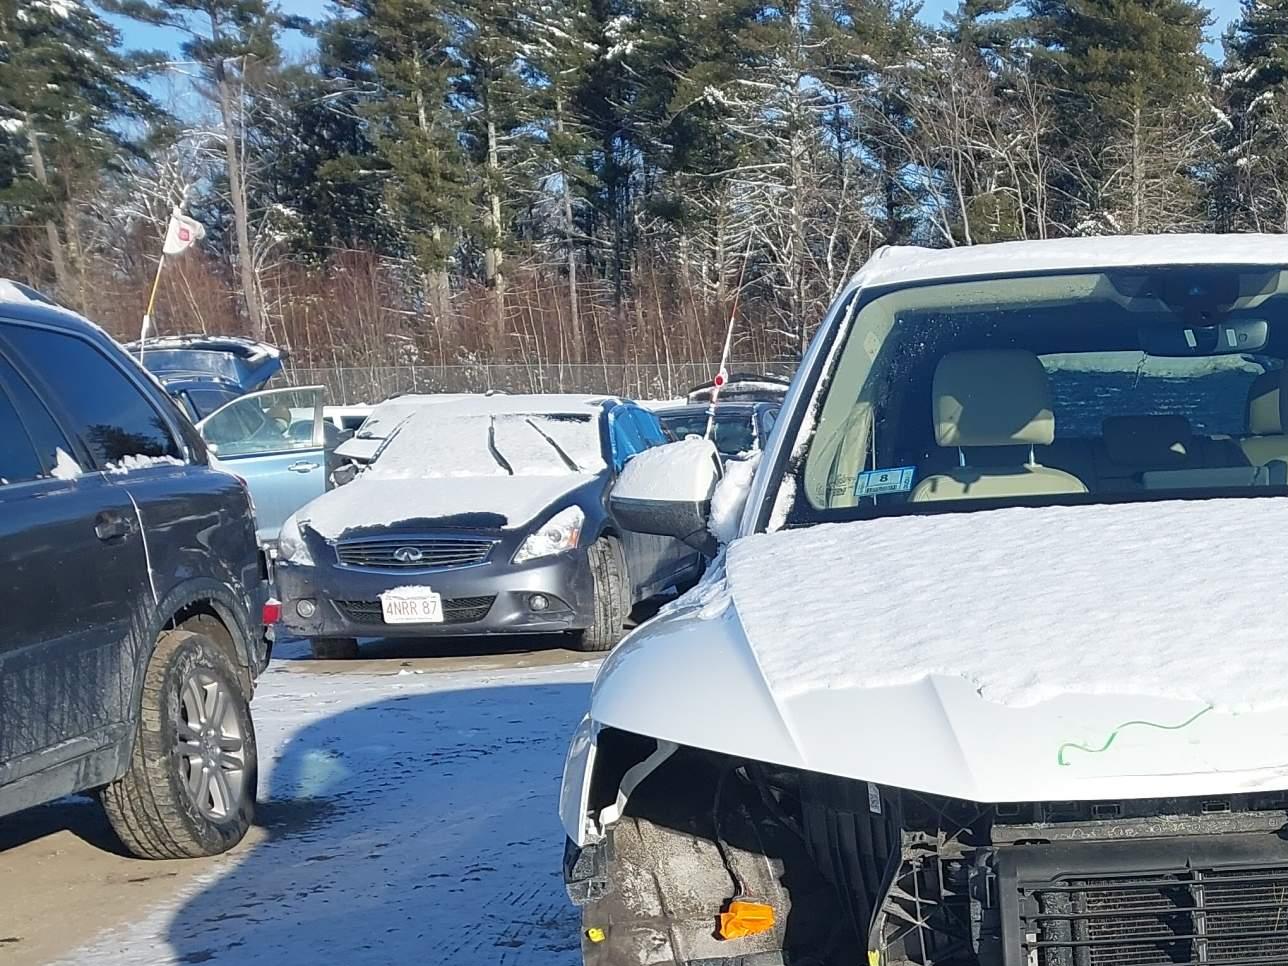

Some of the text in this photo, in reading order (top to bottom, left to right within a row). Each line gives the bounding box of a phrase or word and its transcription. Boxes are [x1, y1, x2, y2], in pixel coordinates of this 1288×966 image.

[879, 474, 889, 483] 8
[386, 600, 437, 616] 4NRR 87
